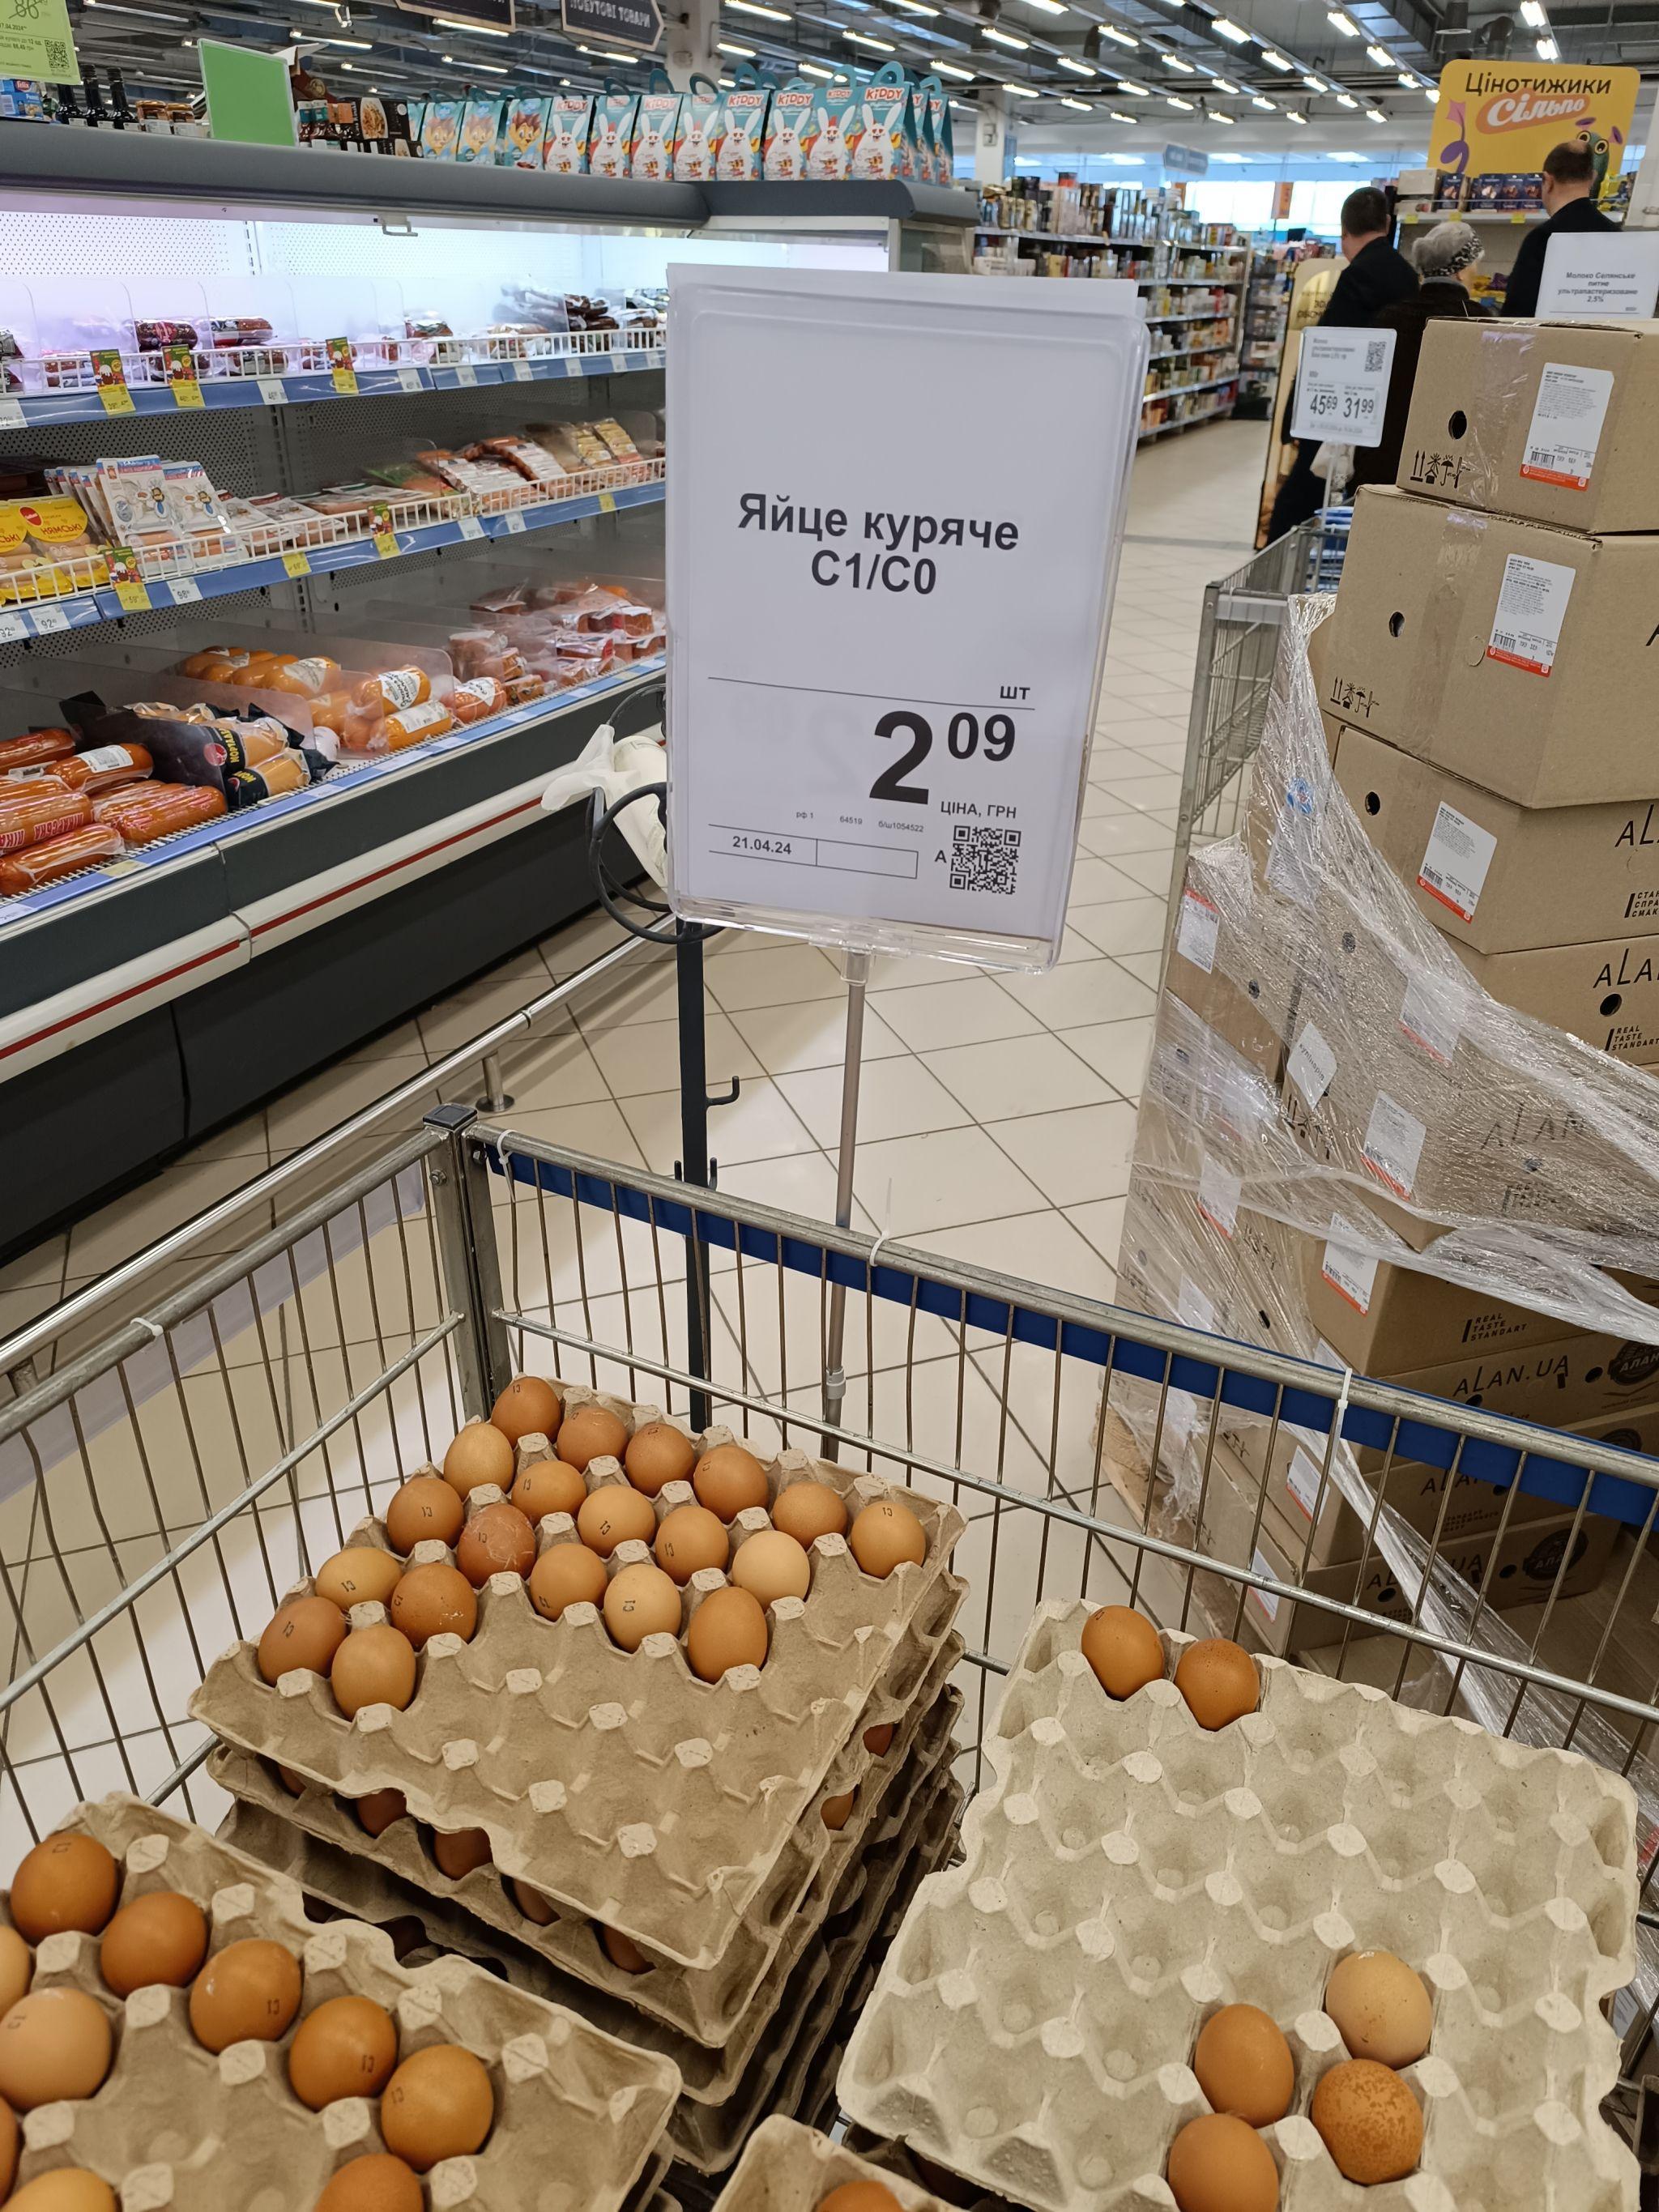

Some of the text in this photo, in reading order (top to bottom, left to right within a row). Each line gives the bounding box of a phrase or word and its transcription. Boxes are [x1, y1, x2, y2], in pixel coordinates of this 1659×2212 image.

[618, 6, 650, 28] ТОВАРИ
[1465, 72, 1612, 96] Цінотижики
[1487, 93, 1585, 126] Сільпо
[1310, 394, 1326, 415] 45
[1343, 398, 1375, 419] 31 99
[738, 492, 1019, 553] Яйце куряче
[869, 710, 1016, 805] 2 09
[840, 815, 863, 825] 64519
[940, 801, 1017, 819] ЦІНА, ГРН
[1614, 803, 1659, 847] AL
[732, 835, 792, 855] 21.04.24
[1593, 948, 1659, 988] ALA
[1614, 1033, 1643, 1043] TASTE
[1617, 1025, 1640, 1034] REAL
[1612, 1038, 1659, 1051] STANDART
[1473, 1320, 1506, 1332] TASTE
[1475, 1313, 1503, 1323] REAL
[1452, 1354, 1569, 1396] ALAN.UA
